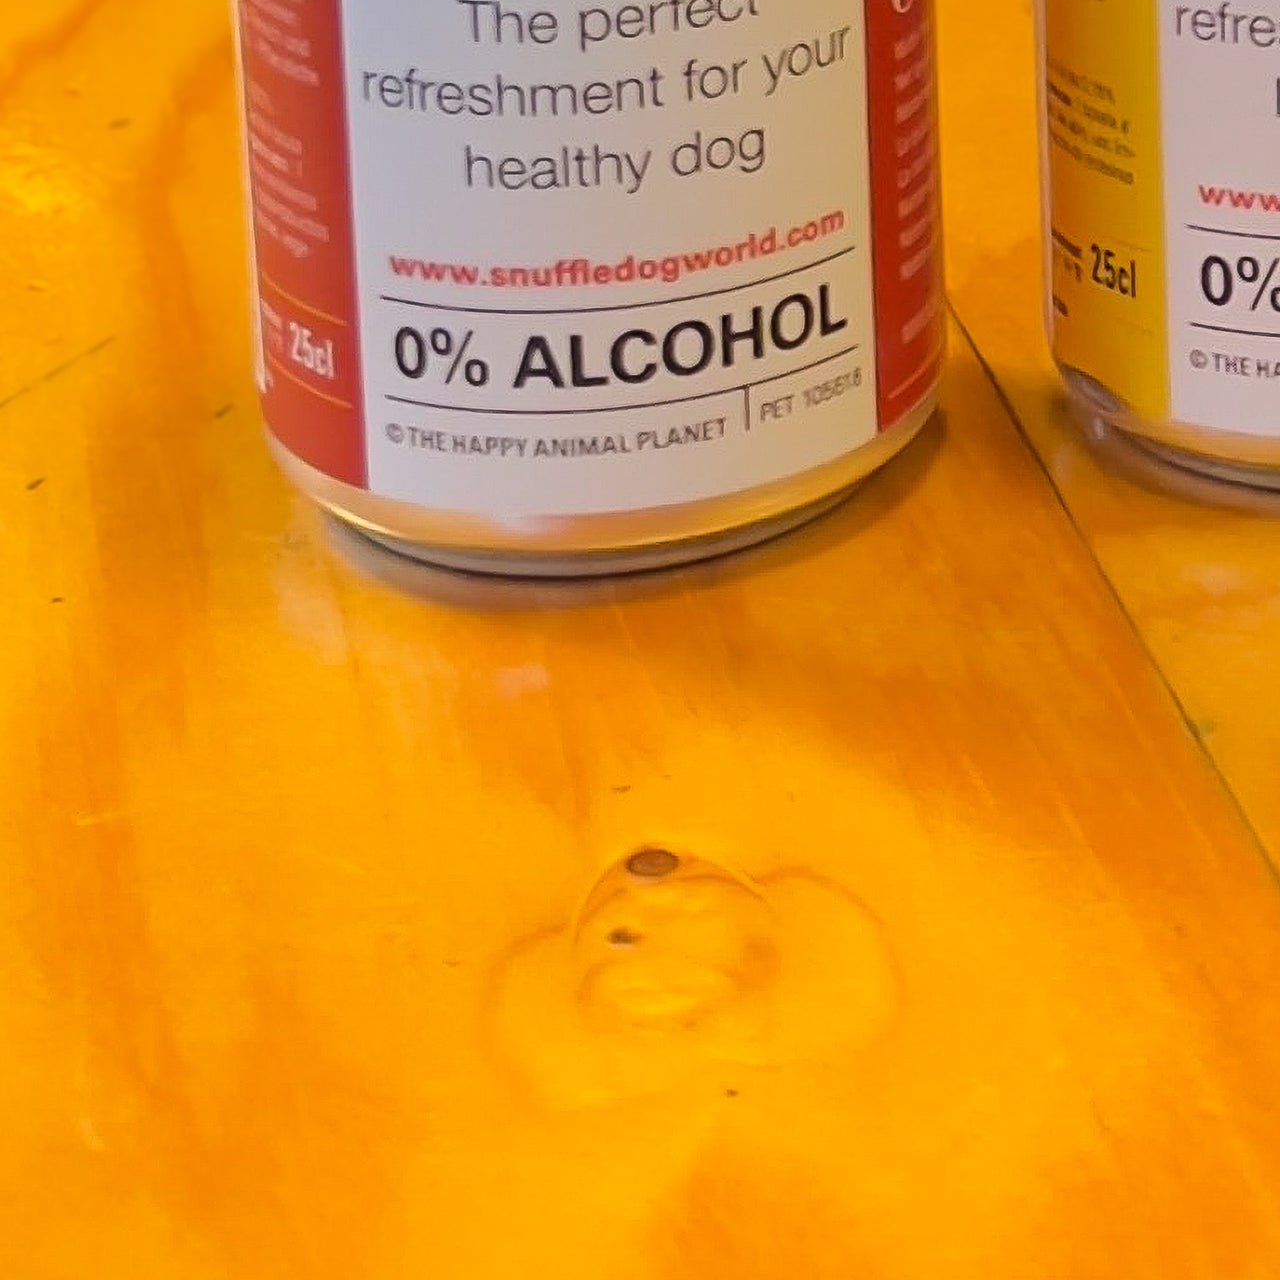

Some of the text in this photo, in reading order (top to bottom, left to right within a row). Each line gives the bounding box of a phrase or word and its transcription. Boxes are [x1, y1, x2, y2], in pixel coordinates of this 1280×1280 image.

[361, 22, 853, 118] refreshment for your
[463, 124, 768, 195] healthy dog
[389, 210, 846, 289] www.snuffledogworld.com
[1089, 243, 1138, 299] 25cl
[287, 321, 335, 379] 25cl
[392, 282, 849, 389] 0% ALCOHOL
[1211, 352, 1250, 376] THE
[407, 426, 451, 453] THE
[452, 432, 526, 458] HAPPY
[532, 431, 631, 458] ANIMAL
[636, 416, 727, 449] PLANET
[760, 393, 795, 422] PET
